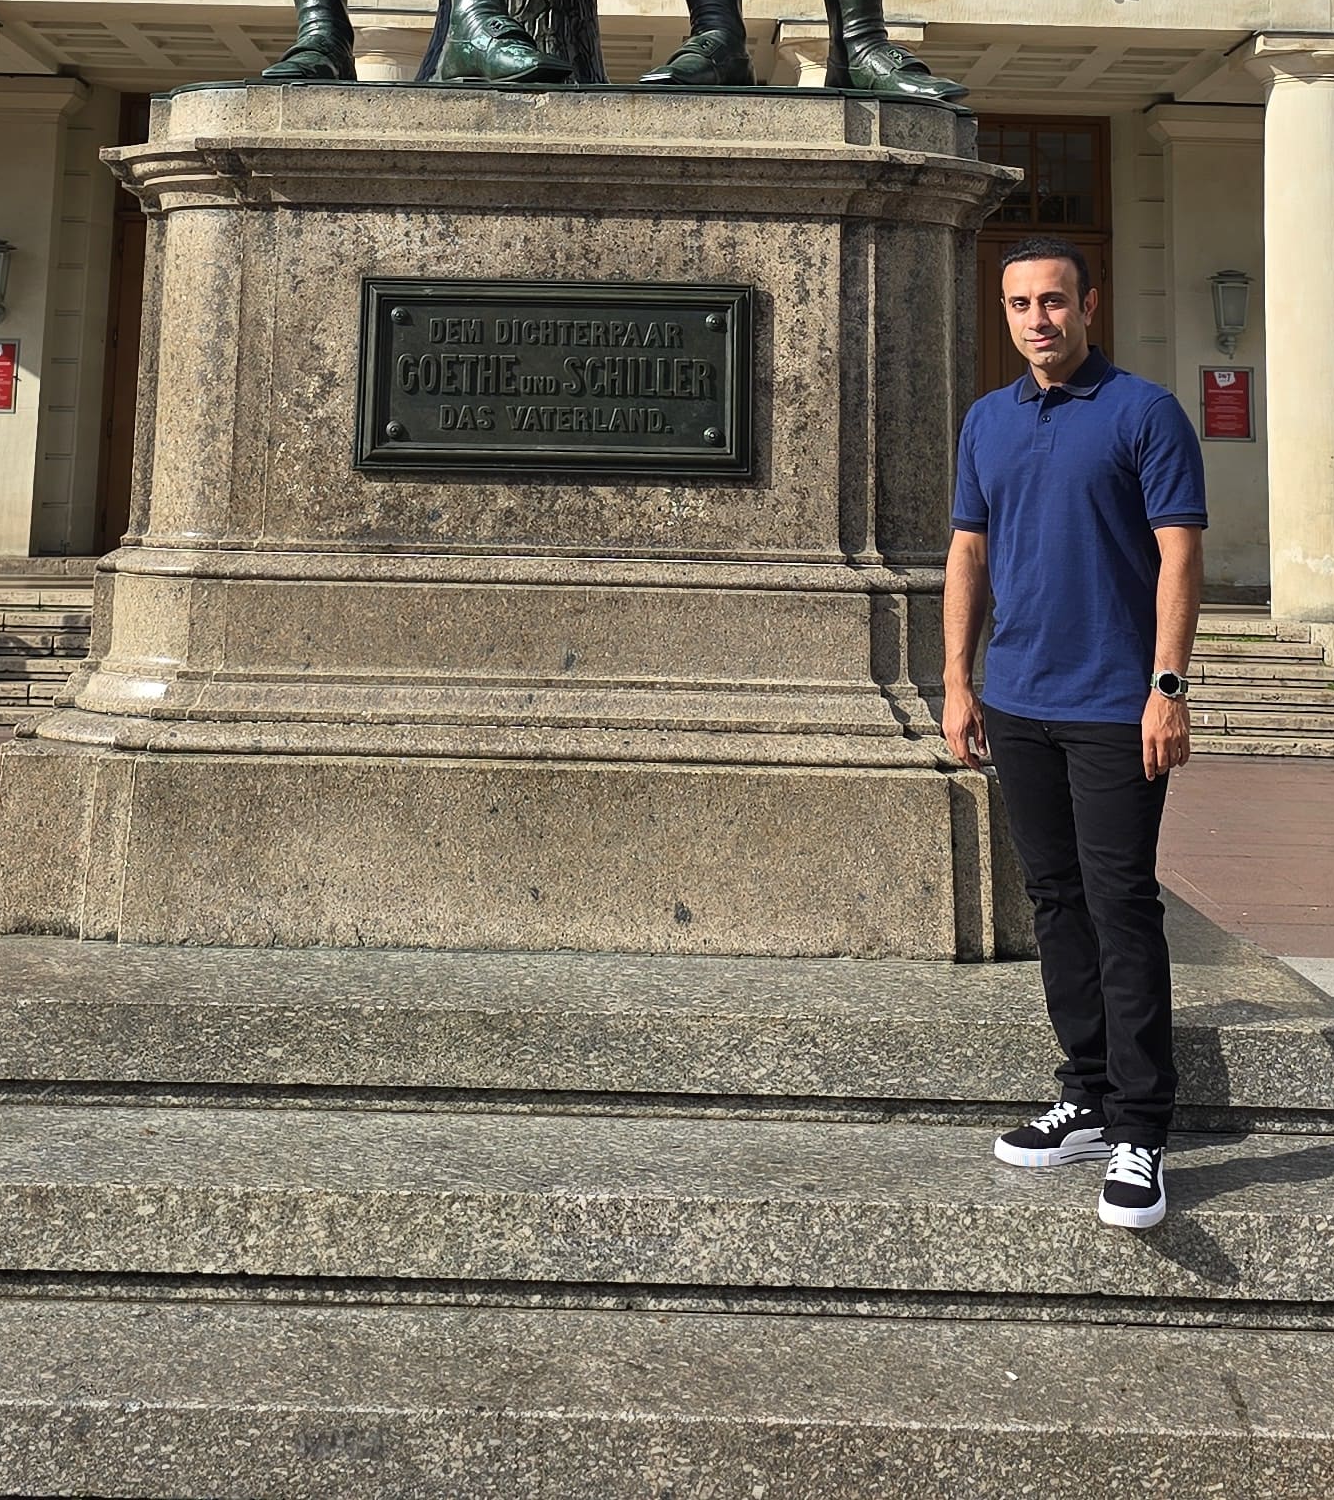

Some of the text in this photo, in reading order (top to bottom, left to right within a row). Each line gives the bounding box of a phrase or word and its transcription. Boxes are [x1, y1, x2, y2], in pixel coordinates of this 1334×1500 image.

[429, 317, 683, 348] DEM DICHTERPAAR
[396, 353, 713, 398] GOETHE UND SCHILLER
[438, 404, 674, 432] DAS VATERLAND.
